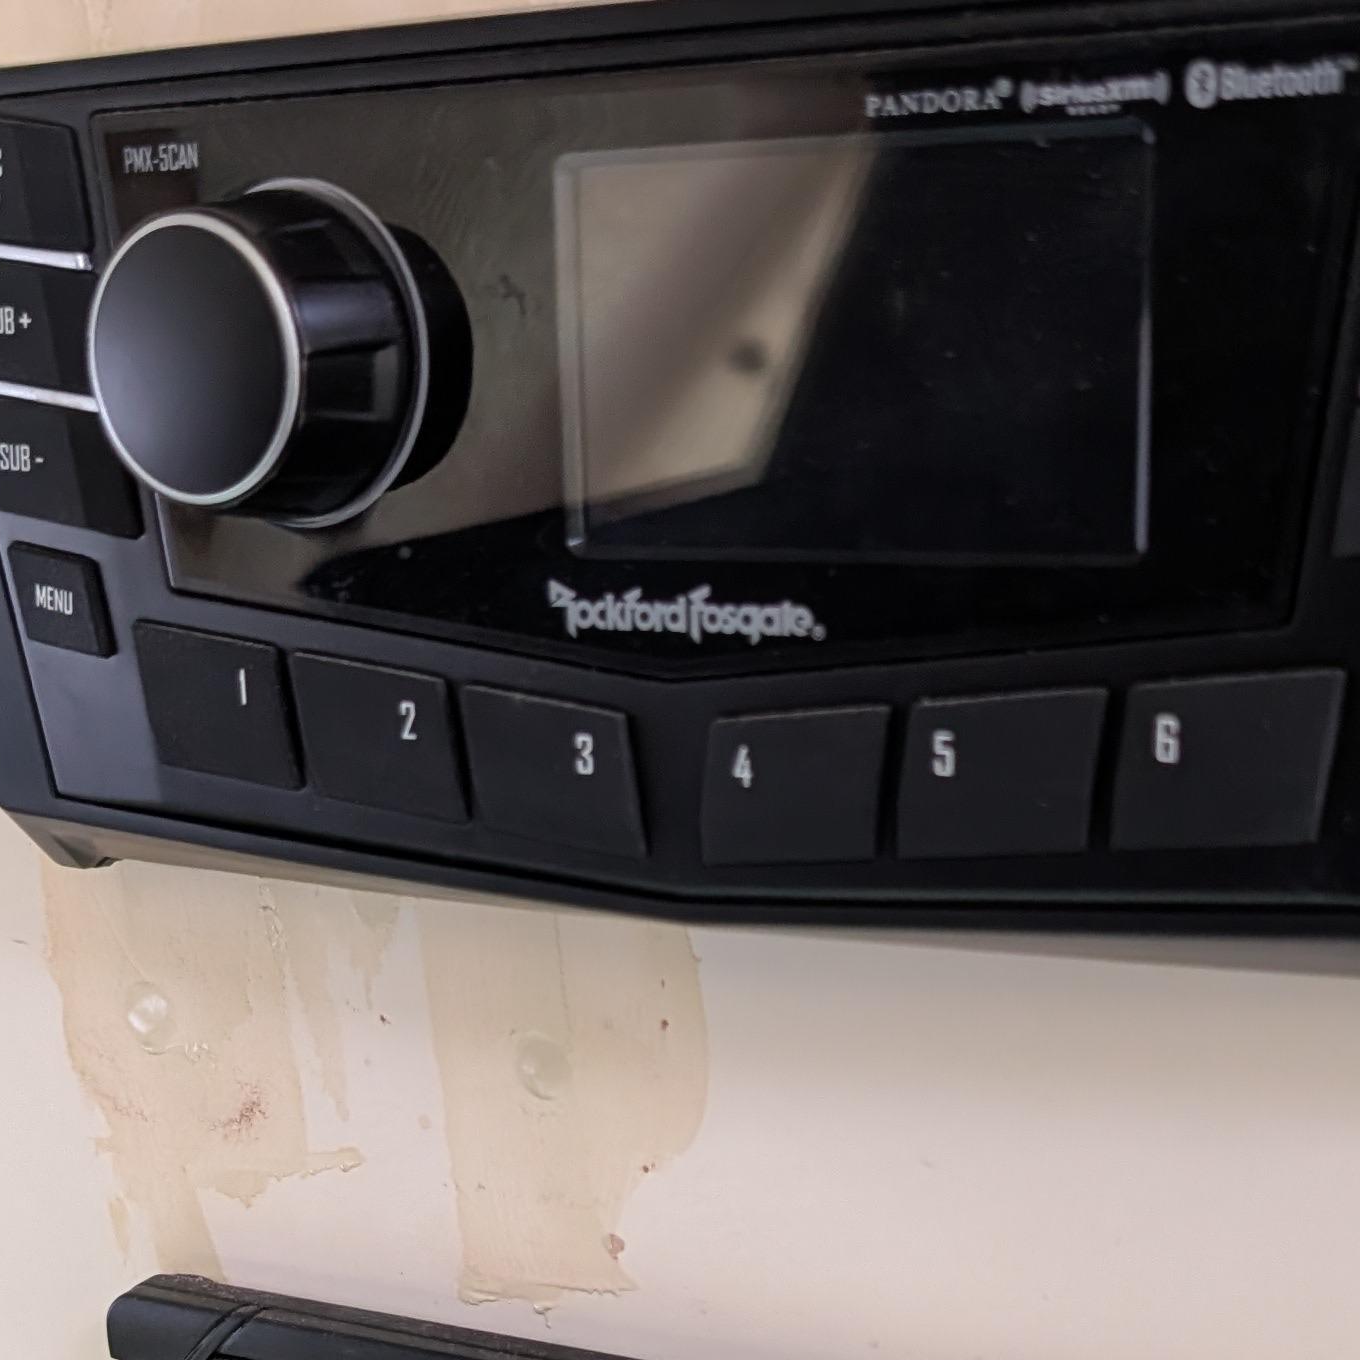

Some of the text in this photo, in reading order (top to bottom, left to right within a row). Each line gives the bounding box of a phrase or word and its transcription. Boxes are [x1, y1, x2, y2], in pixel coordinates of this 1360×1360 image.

[865, 85, 1003, 118] PANDORA
[34, 584, 75, 616] MENU
[239, 668, 248, 706] 1
[399, 701, 418, 741] 2
[1153, 712, 1181, 765] 6
[573, 732, 595, 777] 3
[731, 745, 753, 788] 4
[931, 729, 956, 777] 5
